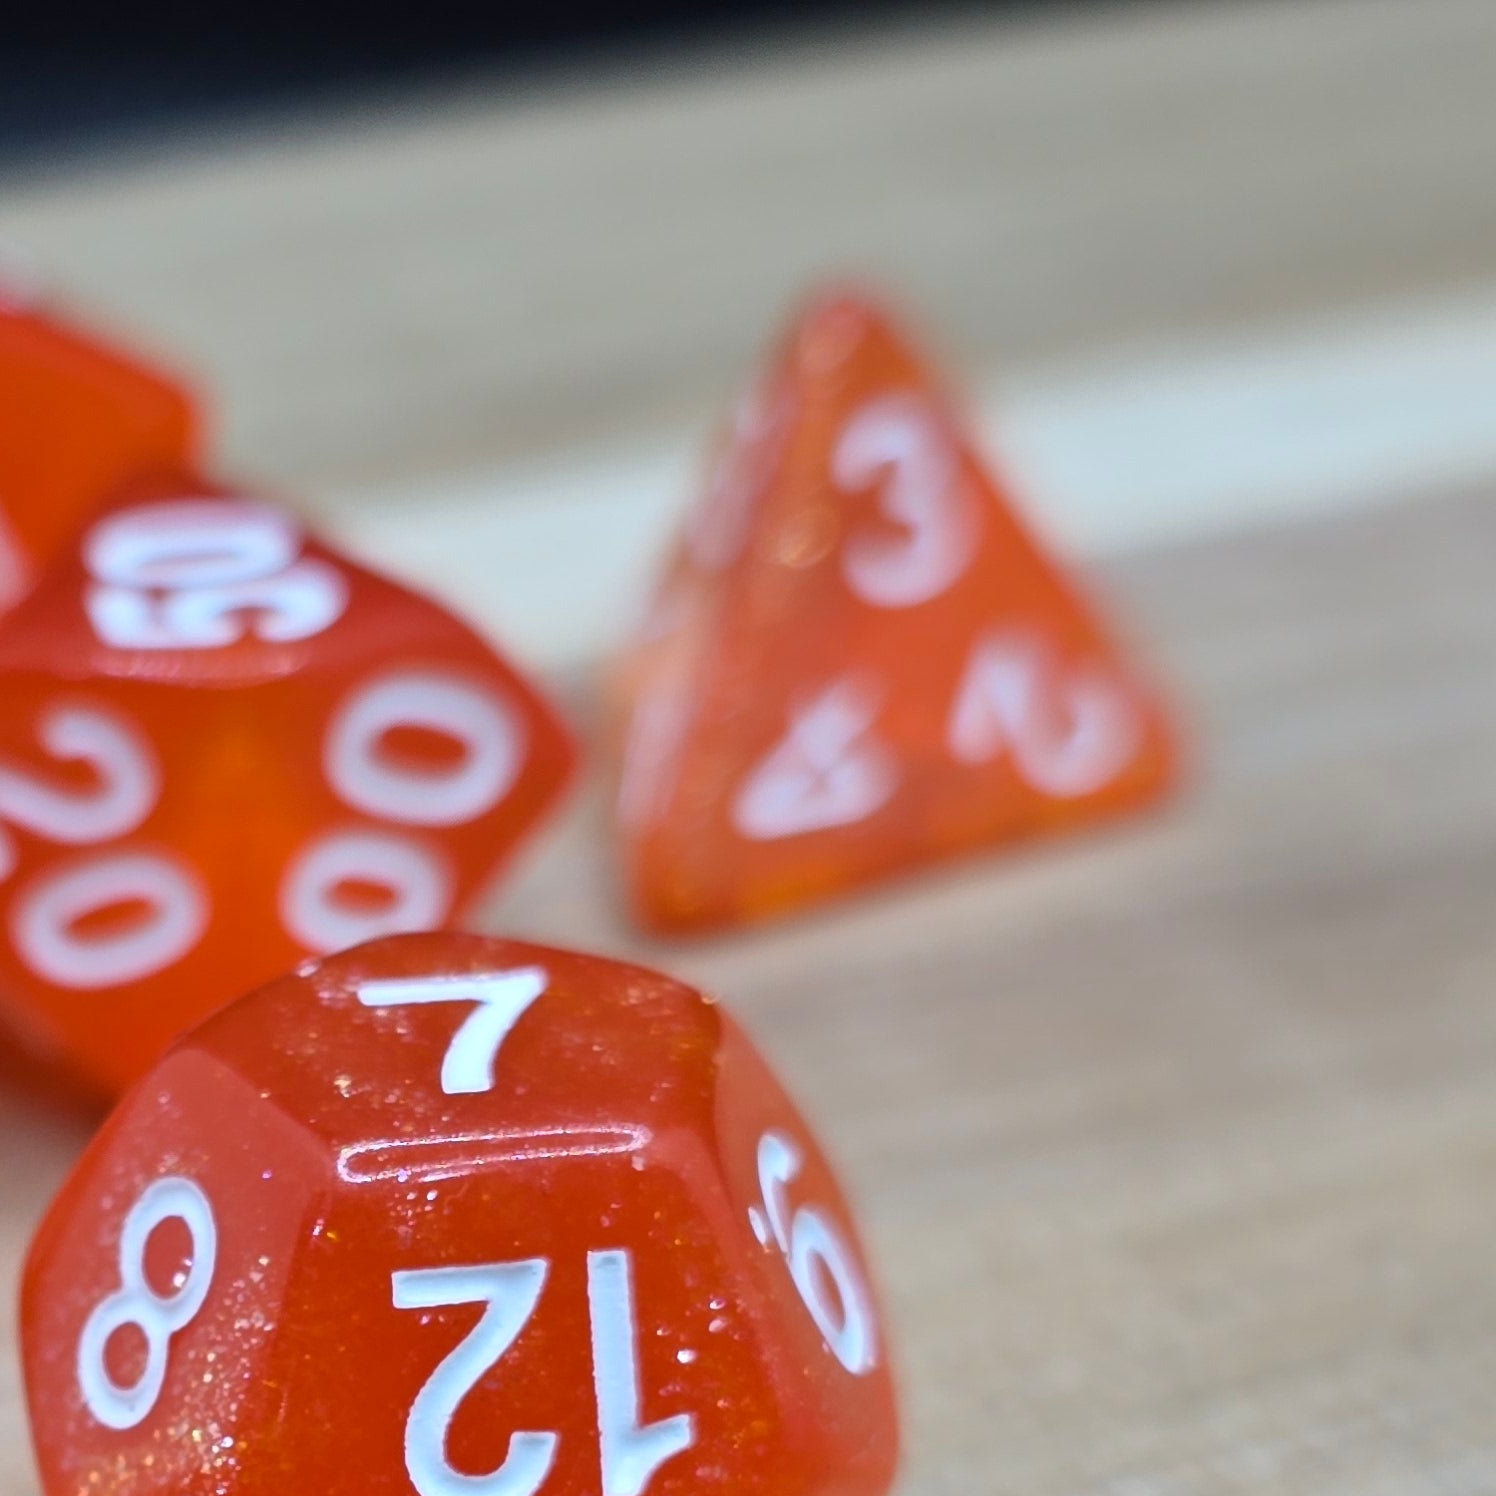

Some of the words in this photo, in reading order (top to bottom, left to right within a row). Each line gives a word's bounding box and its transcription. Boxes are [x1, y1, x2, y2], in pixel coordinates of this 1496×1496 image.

[829, 398, 982, 610] 3
[357, 966, 548, 1095] 7
[78, 1177, 217, 1430] 8
